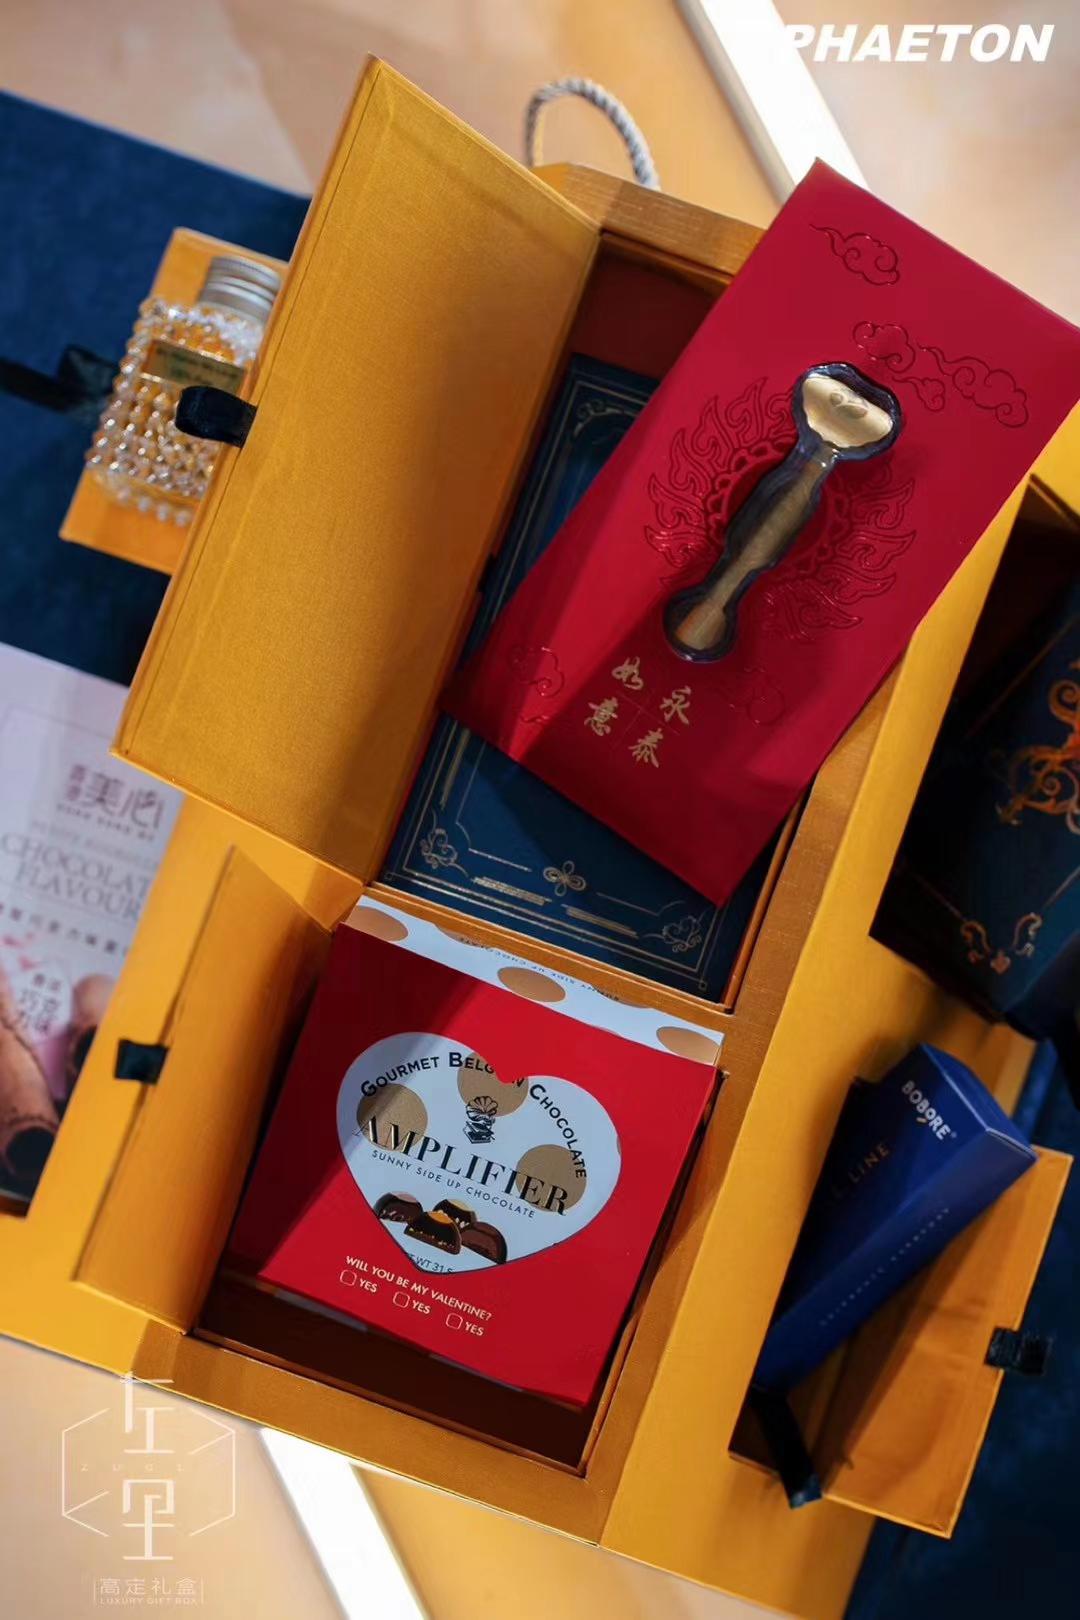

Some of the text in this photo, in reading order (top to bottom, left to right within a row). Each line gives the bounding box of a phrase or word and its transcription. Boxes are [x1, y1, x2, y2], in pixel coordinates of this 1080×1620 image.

[361, 1056, 440, 1098] GOURMET
[529, 1084, 588, 1179] CHOCOLATE
[352, 1115, 569, 1217] AMPLIFIER
[372, 1149, 536, 1219] SUNNY SIDE UP CHOCOLATE
[345, 1255, 493, 1322] WILL YOU BE MY VALENTINE?
[359, 1277, 379, 1294] YES
[411, 1299, 432, 1315] YES
[464, 1321, 485, 1337] YES
